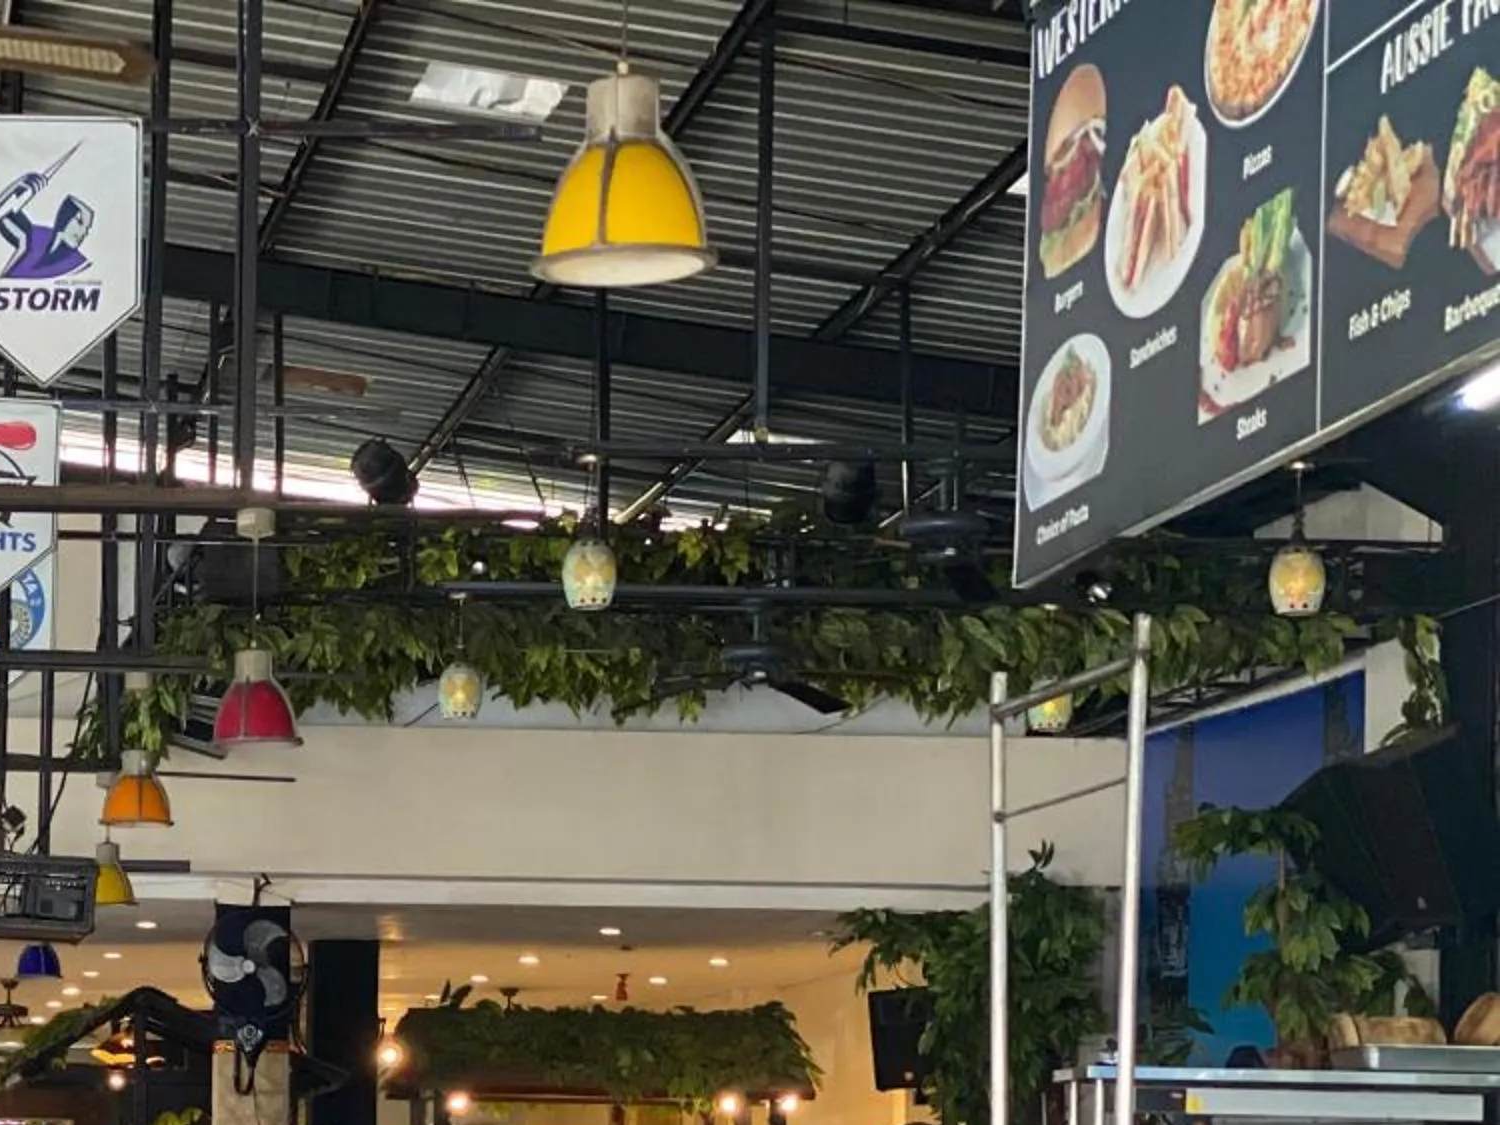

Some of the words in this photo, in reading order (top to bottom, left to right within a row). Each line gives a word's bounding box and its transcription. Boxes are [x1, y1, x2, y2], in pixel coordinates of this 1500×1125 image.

[1037, 0, 1130, 79] WESTER
[1380, 0, 1455, 94] AUSSIE
[1236, 407, 1268, 440] Steaks
